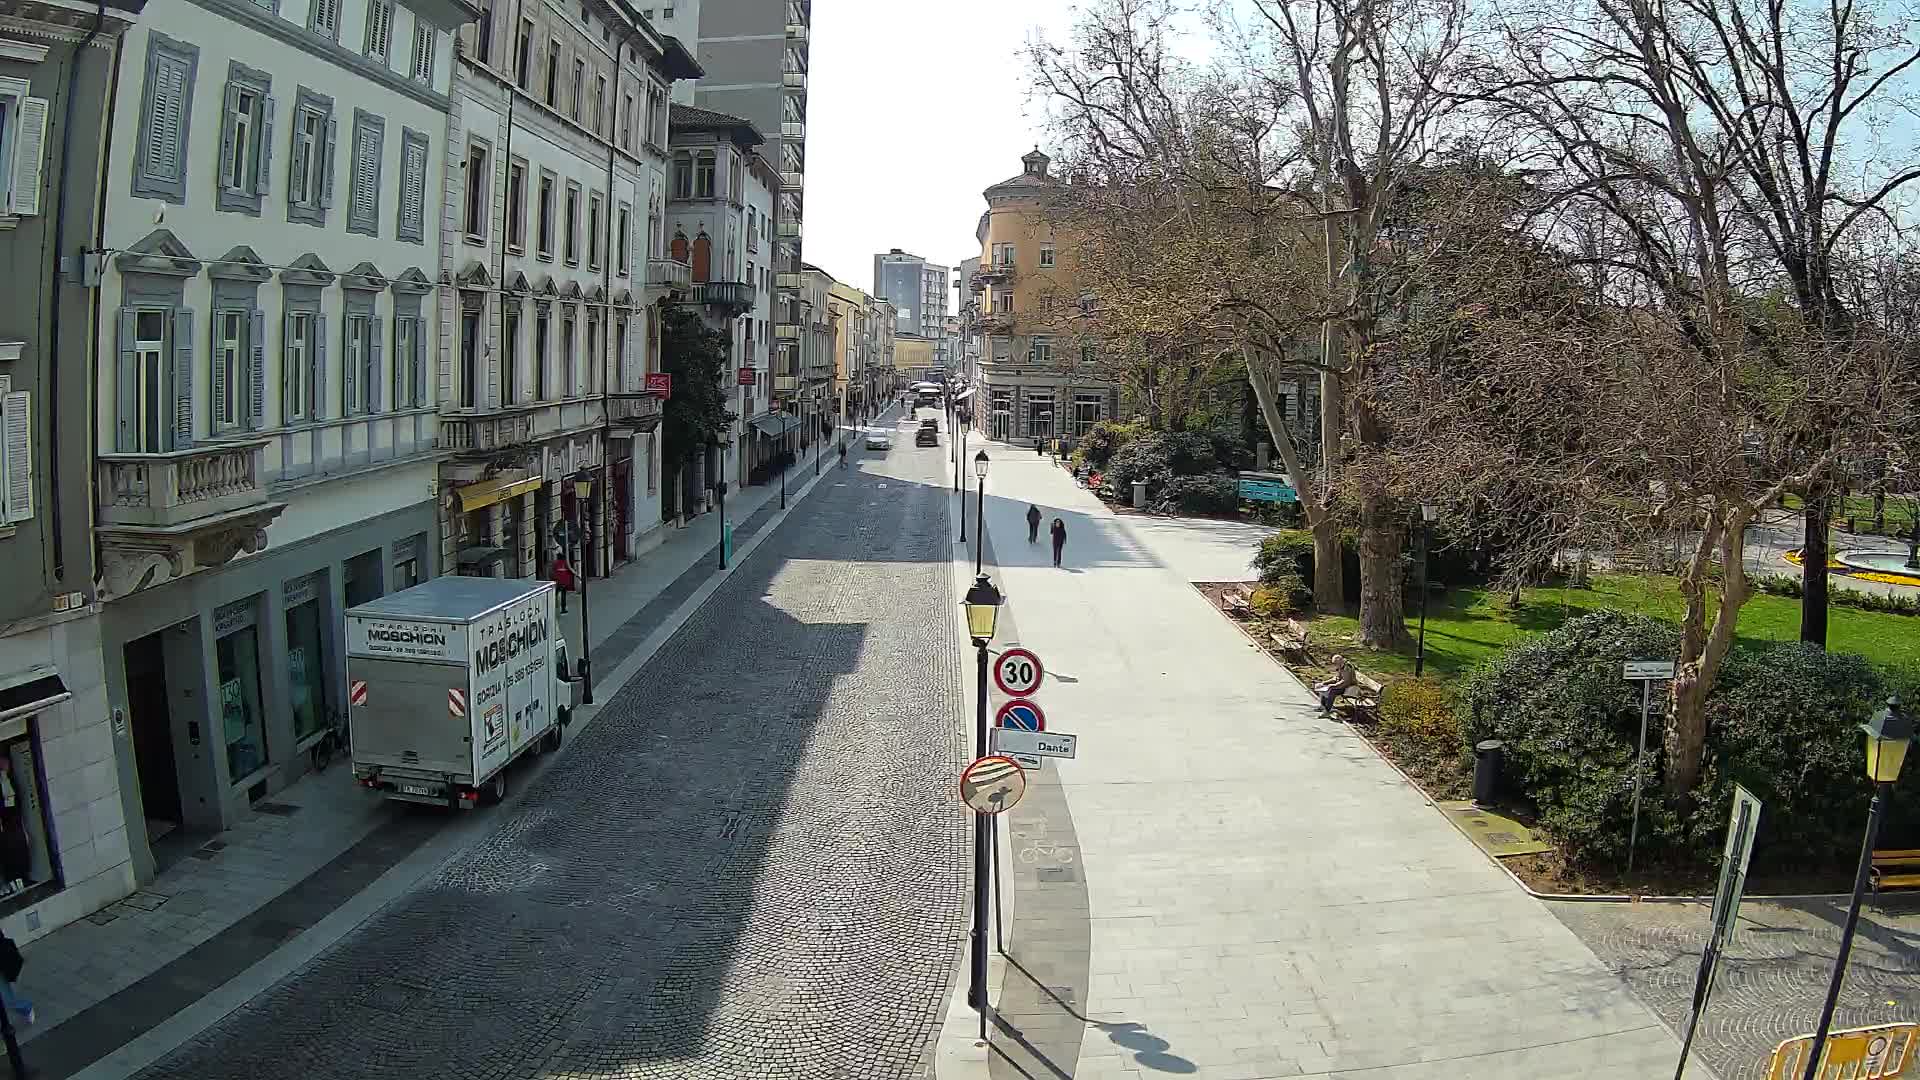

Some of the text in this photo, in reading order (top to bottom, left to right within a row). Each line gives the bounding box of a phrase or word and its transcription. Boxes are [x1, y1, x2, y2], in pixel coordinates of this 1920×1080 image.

[368, 629, 446, 646] MOSCHION
[475, 618, 547, 678] MOSCHION
[1005, 662, 1033, 684] 30
[1038, 742, 1070, 753] Dante
